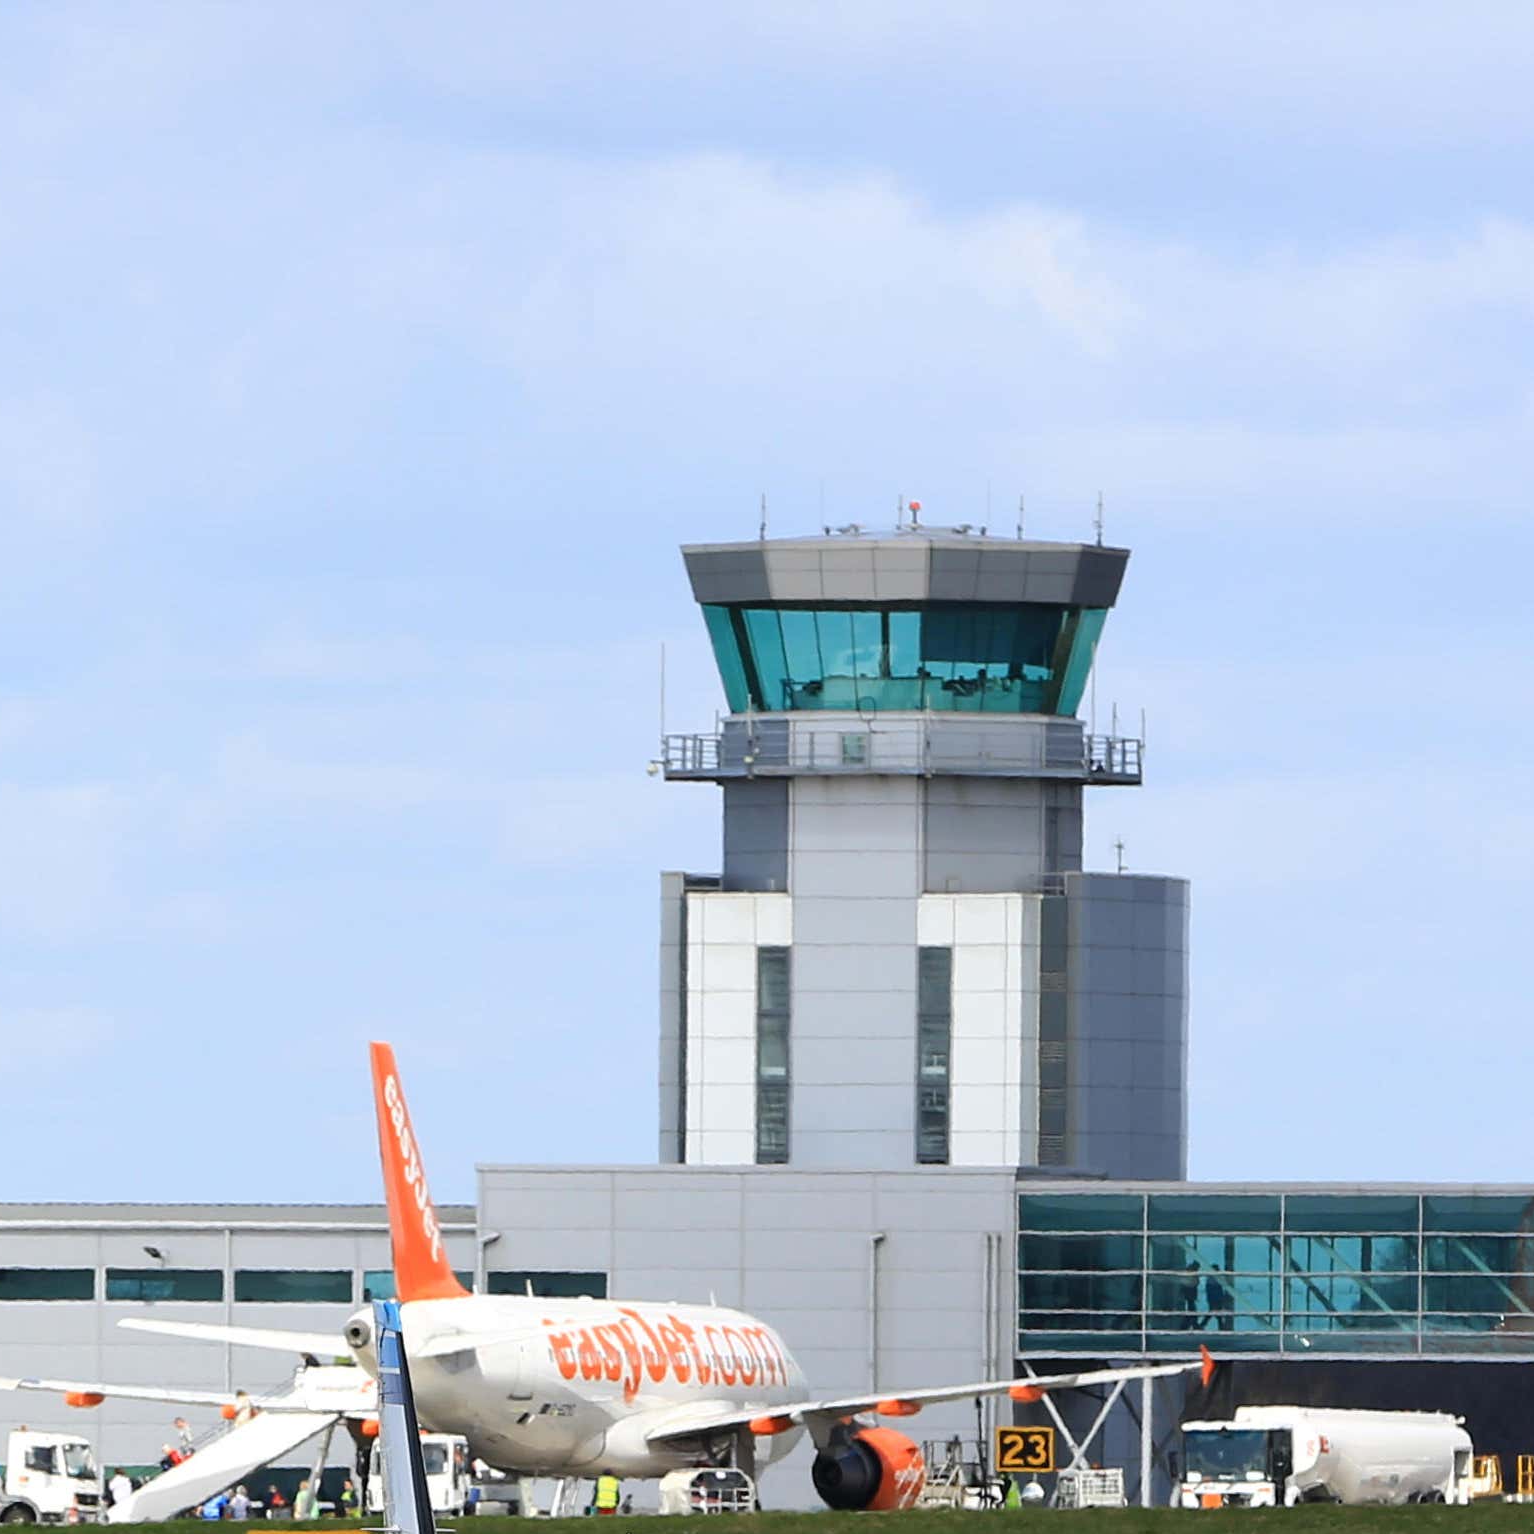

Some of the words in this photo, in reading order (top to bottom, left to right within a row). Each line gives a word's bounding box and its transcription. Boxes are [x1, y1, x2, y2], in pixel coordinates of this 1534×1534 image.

[383, 1074, 443, 1264] easyJet
[544, 1307, 787, 1403] easyJet.com
[1002, 1434, 1047, 1466] 23
